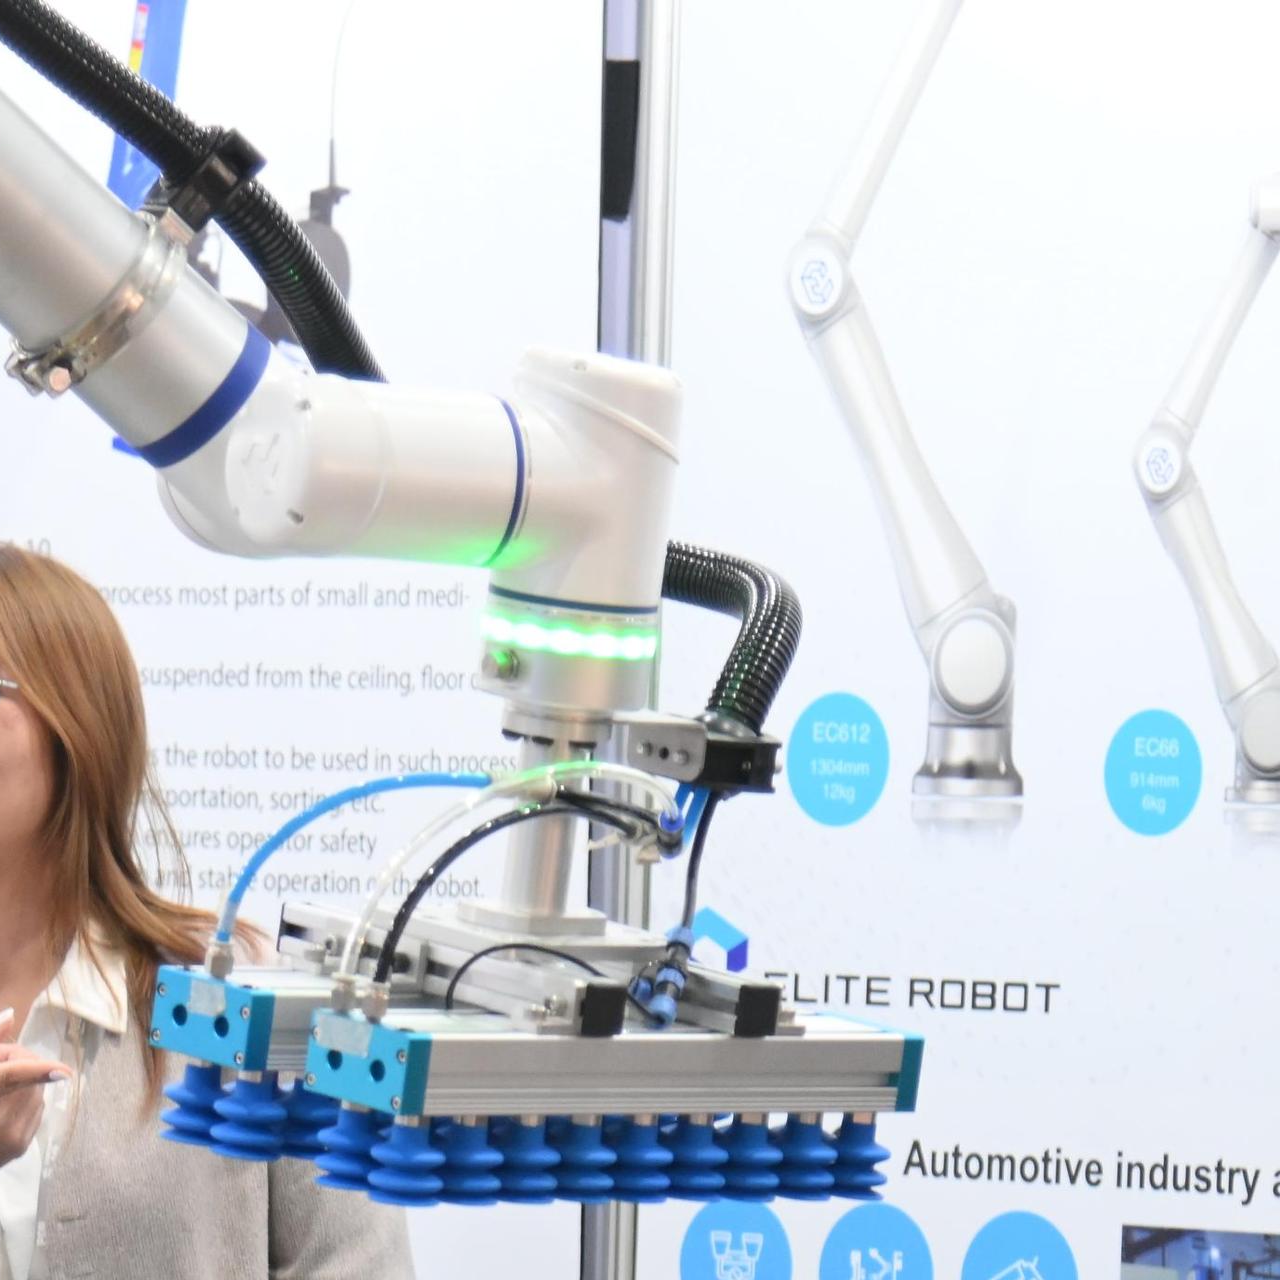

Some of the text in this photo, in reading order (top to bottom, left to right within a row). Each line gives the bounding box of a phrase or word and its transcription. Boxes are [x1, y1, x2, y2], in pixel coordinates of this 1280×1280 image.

[178, 584, 228, 607] most
[234, 585, 285, 611] parts
[291, 582, 312, 607] of
[318, 583, 369, 608] small
[374, 584, 410, 608] and
[140, 662, 249, 693] suspended
[255, 662, 303, 688] from
[309, 665, 342, 690] the
[347, 667, 415, 698] ceiling,
[420, 665, 464, 692] floor
[813, 721, 871, 745] EC612
[1134, 736, 1180, 759] EC66
[165, 744, 195, 767] the
[203, 746, 257, 768] robot
[265, 748, 283, 769] to
[291, 747, 316, 769] be
[322, 748, 368, 772] used
[375, 750, 392, 771] in
[398, 749, 441, 773] such
[319, 829, 378, 861] safety
[263, 868, 356, 899] operation
[908, 978, 1061, 1013] ROBOT
[902, 1138, 1103, 1188] Automotive
[1115, 1150, 1261, 1206] industry
